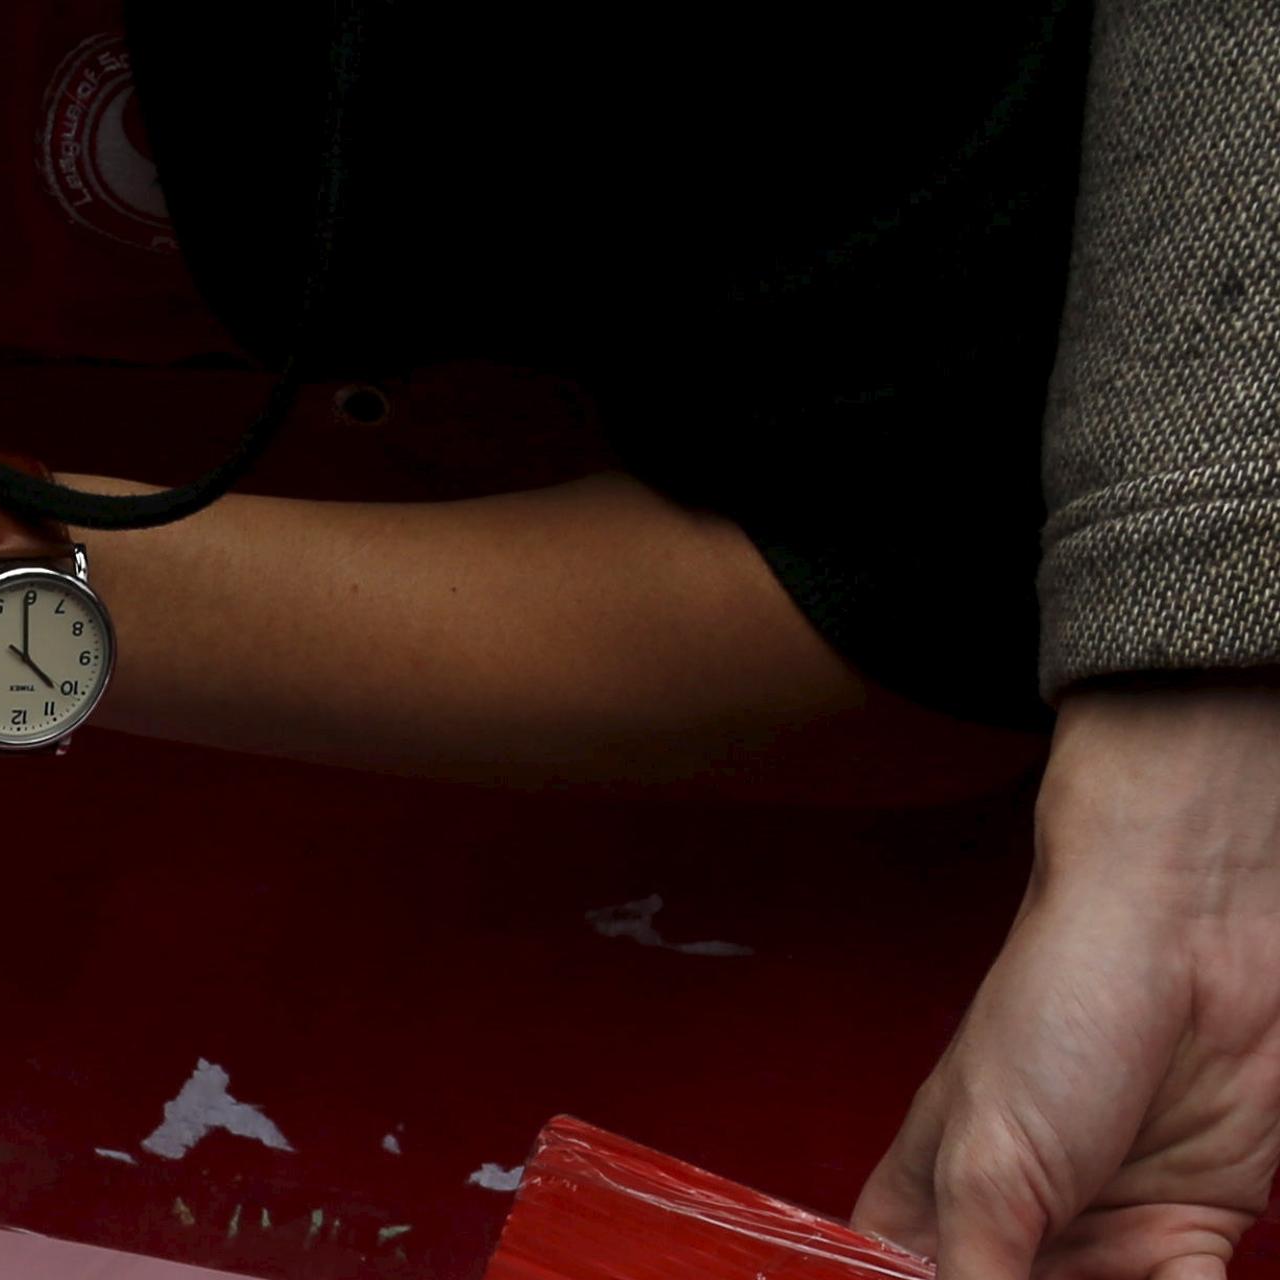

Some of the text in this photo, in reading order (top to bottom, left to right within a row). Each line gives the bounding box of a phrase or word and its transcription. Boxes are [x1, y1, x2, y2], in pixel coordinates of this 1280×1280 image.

[54, 599, 66, 615] 7
[72, 621, 84, 637] 8
[79, 650, 91, 666] 9
[60, 680, 79, 697] 10
[11, 709, 28, 725] 12
[43, 702, 55, 717] 11
